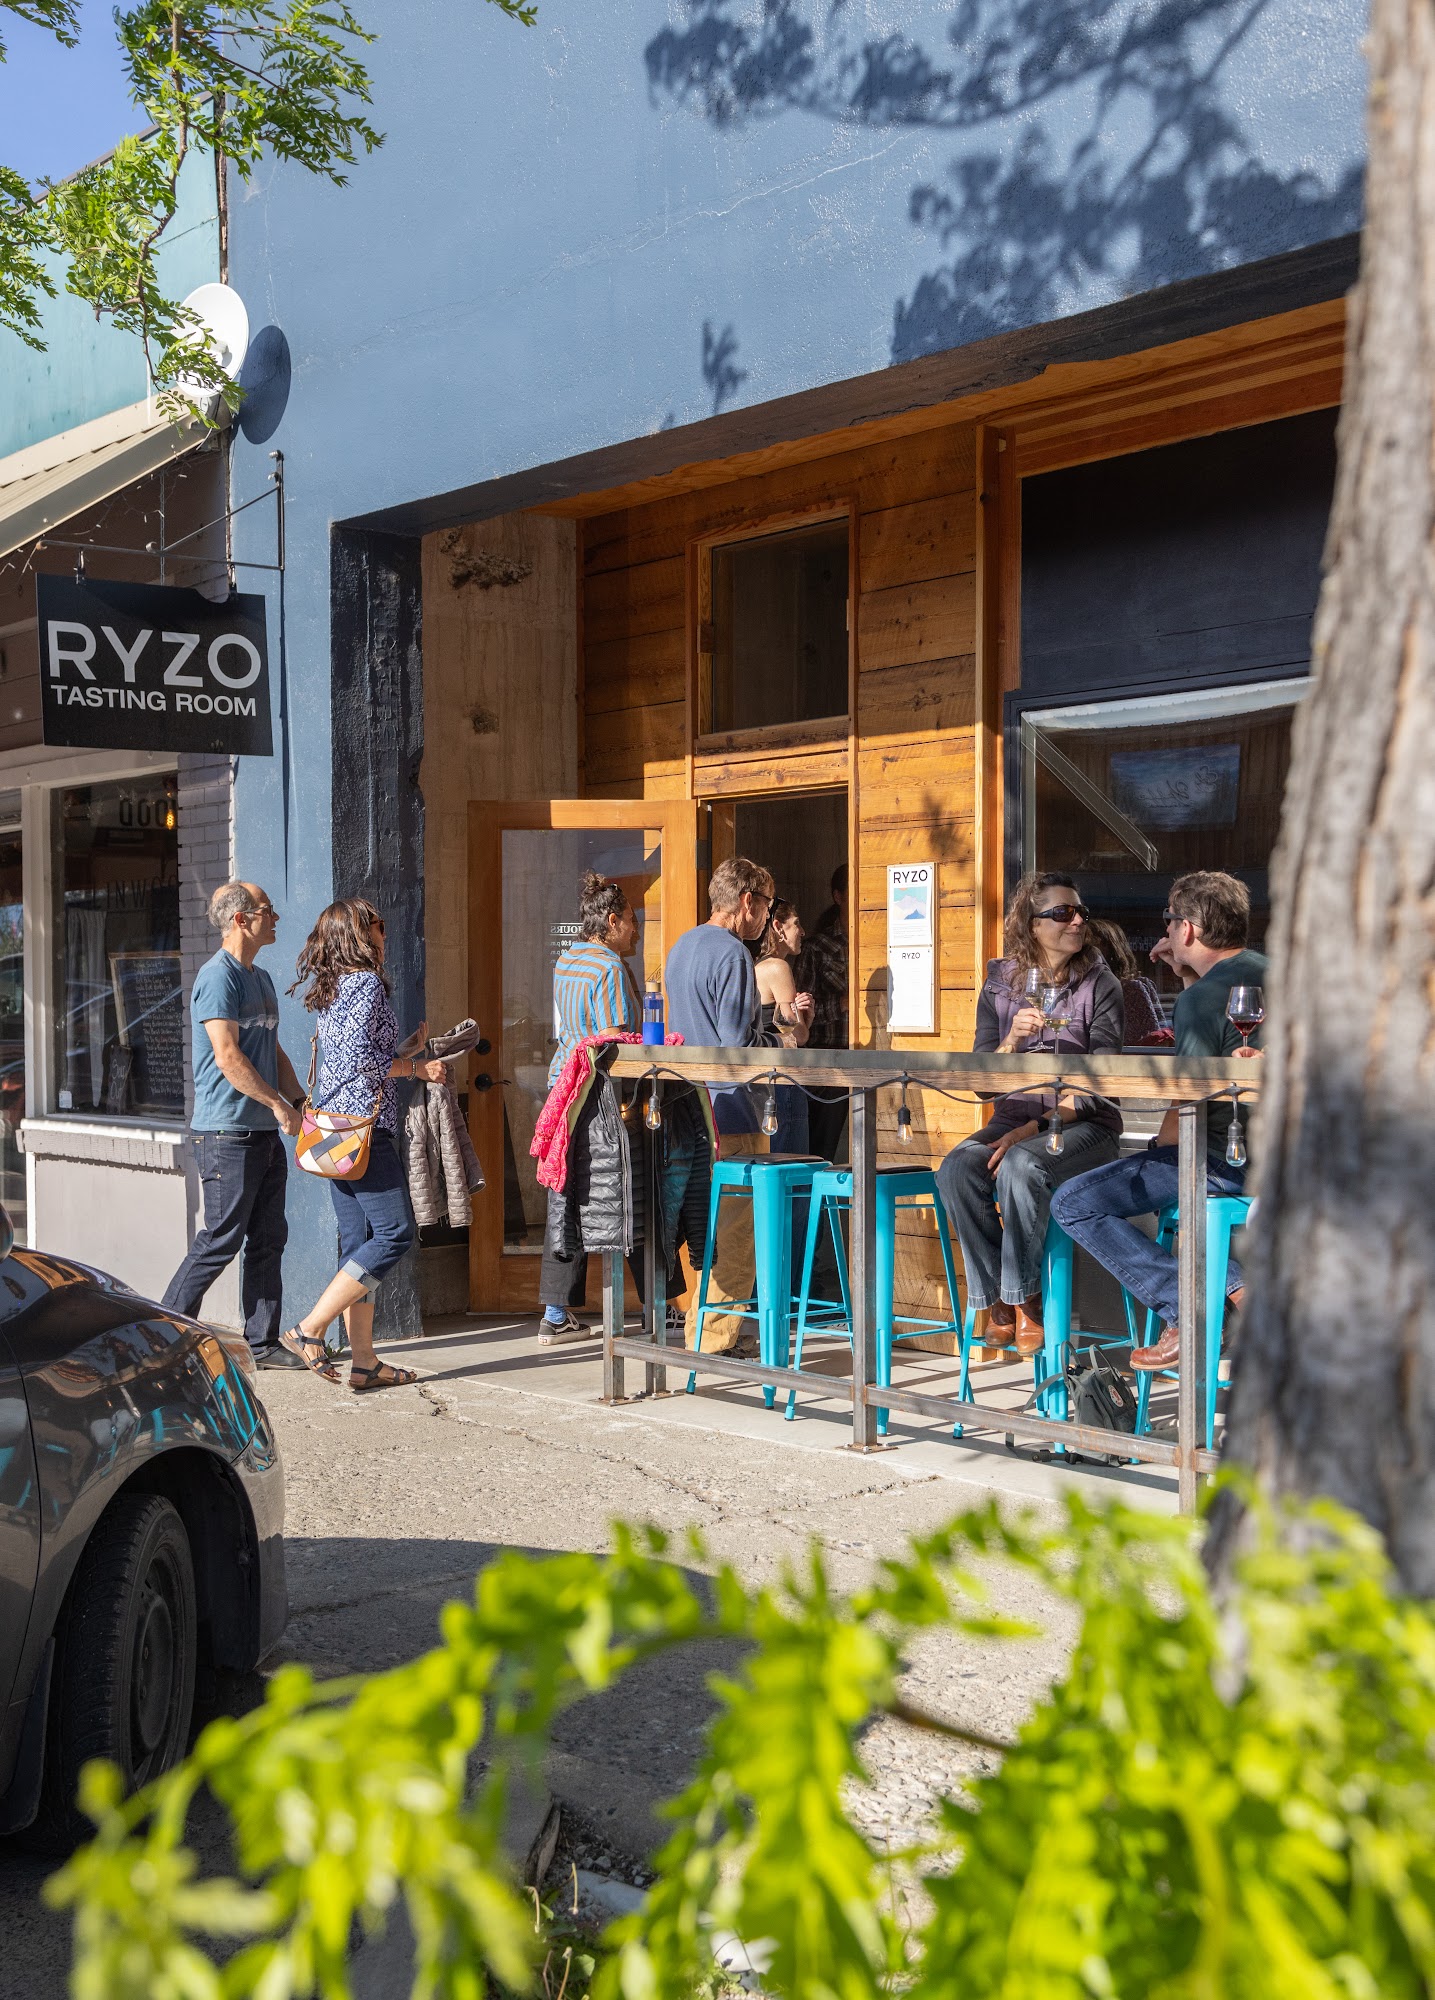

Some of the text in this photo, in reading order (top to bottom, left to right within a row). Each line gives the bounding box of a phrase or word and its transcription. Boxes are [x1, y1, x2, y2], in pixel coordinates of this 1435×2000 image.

[47, 620, 261, 689] RYZO
[50, 684, 257, 717] TASTING ROOM
[893, 869, 928, 884] RYZO
[901, 952, 921, 960] RYZO
